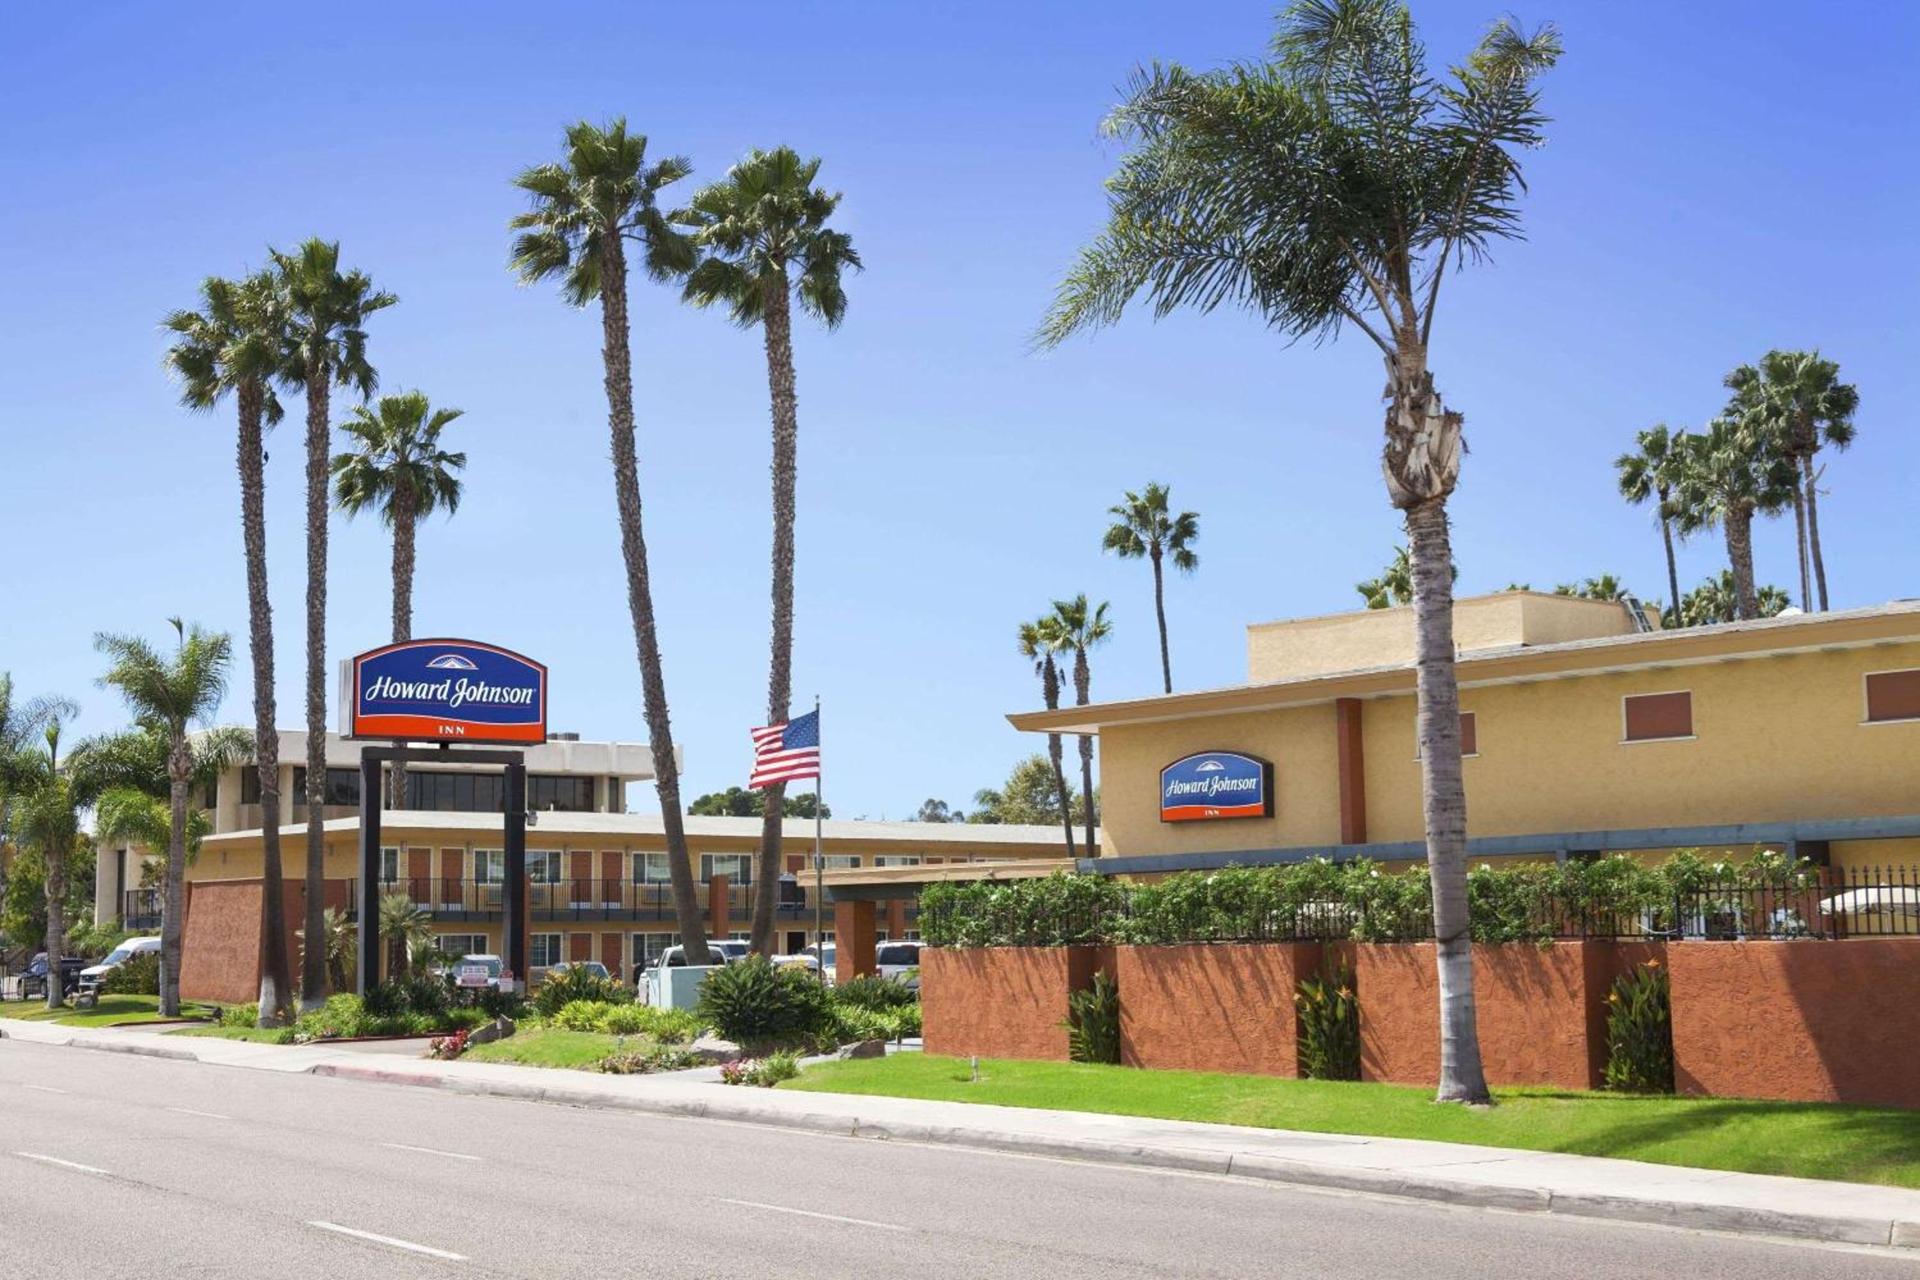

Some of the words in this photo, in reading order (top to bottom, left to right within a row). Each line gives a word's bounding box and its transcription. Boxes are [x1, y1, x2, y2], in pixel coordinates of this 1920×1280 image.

[366, 676, 450, 701] Howard
[450, 678, 534, 708] Johnson
[438, 725, 465, 735] INN
[1166, 778, 1209, 798] Howard
[1209, 776, 1257, 797] Johnson
